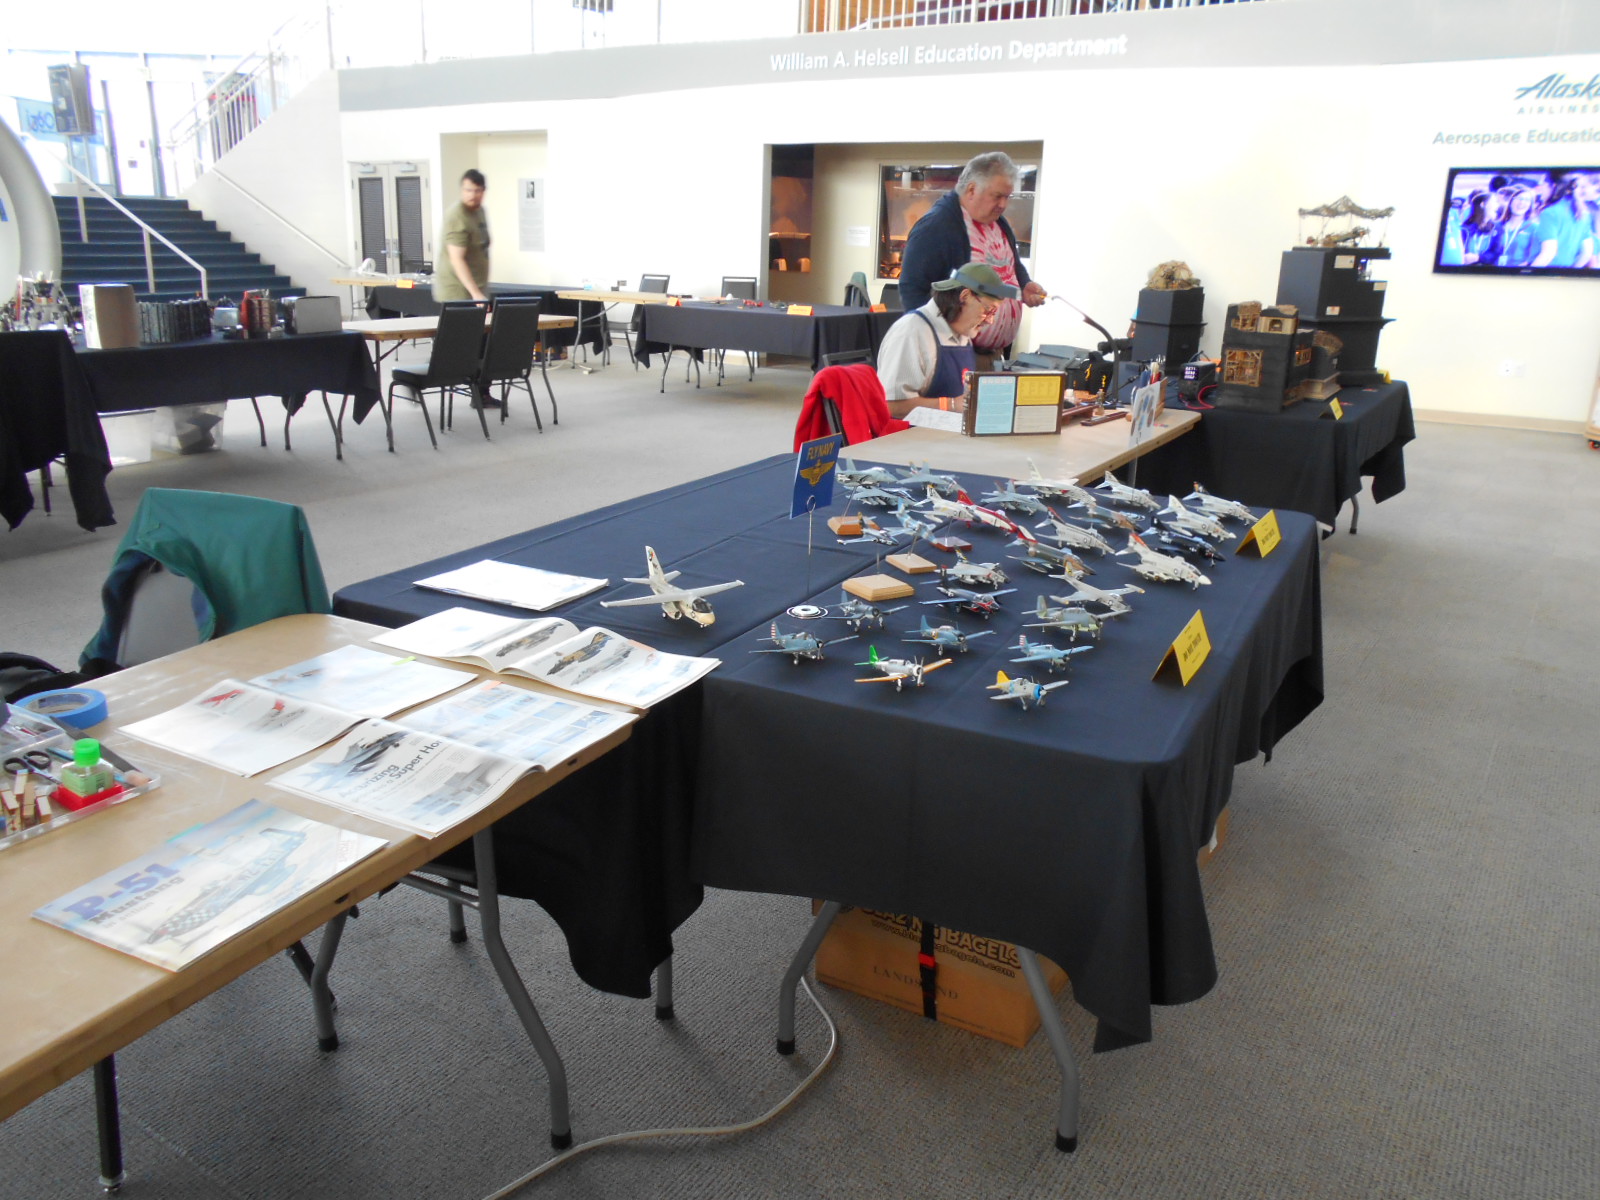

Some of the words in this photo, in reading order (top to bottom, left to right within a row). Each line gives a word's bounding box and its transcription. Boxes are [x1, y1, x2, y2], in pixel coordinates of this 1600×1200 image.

[770, 52, 828, 72] William
[834, 50, 850, 68] A.
[854, 46, 909, 67] Helsell
[914, 41, 1003, 65] Education
[1008, 34, 1129, 63] Department
[1517, 104, 1600, 115] AIRLINES
[1432, 131, 1520, 147] Aerospace
[389, 754, 424, 780] Super
[62, 863, 181, 920] P-51
[89, 876, 185, 924] Mustang
[945, 925, 1022, 969] BAGELS
